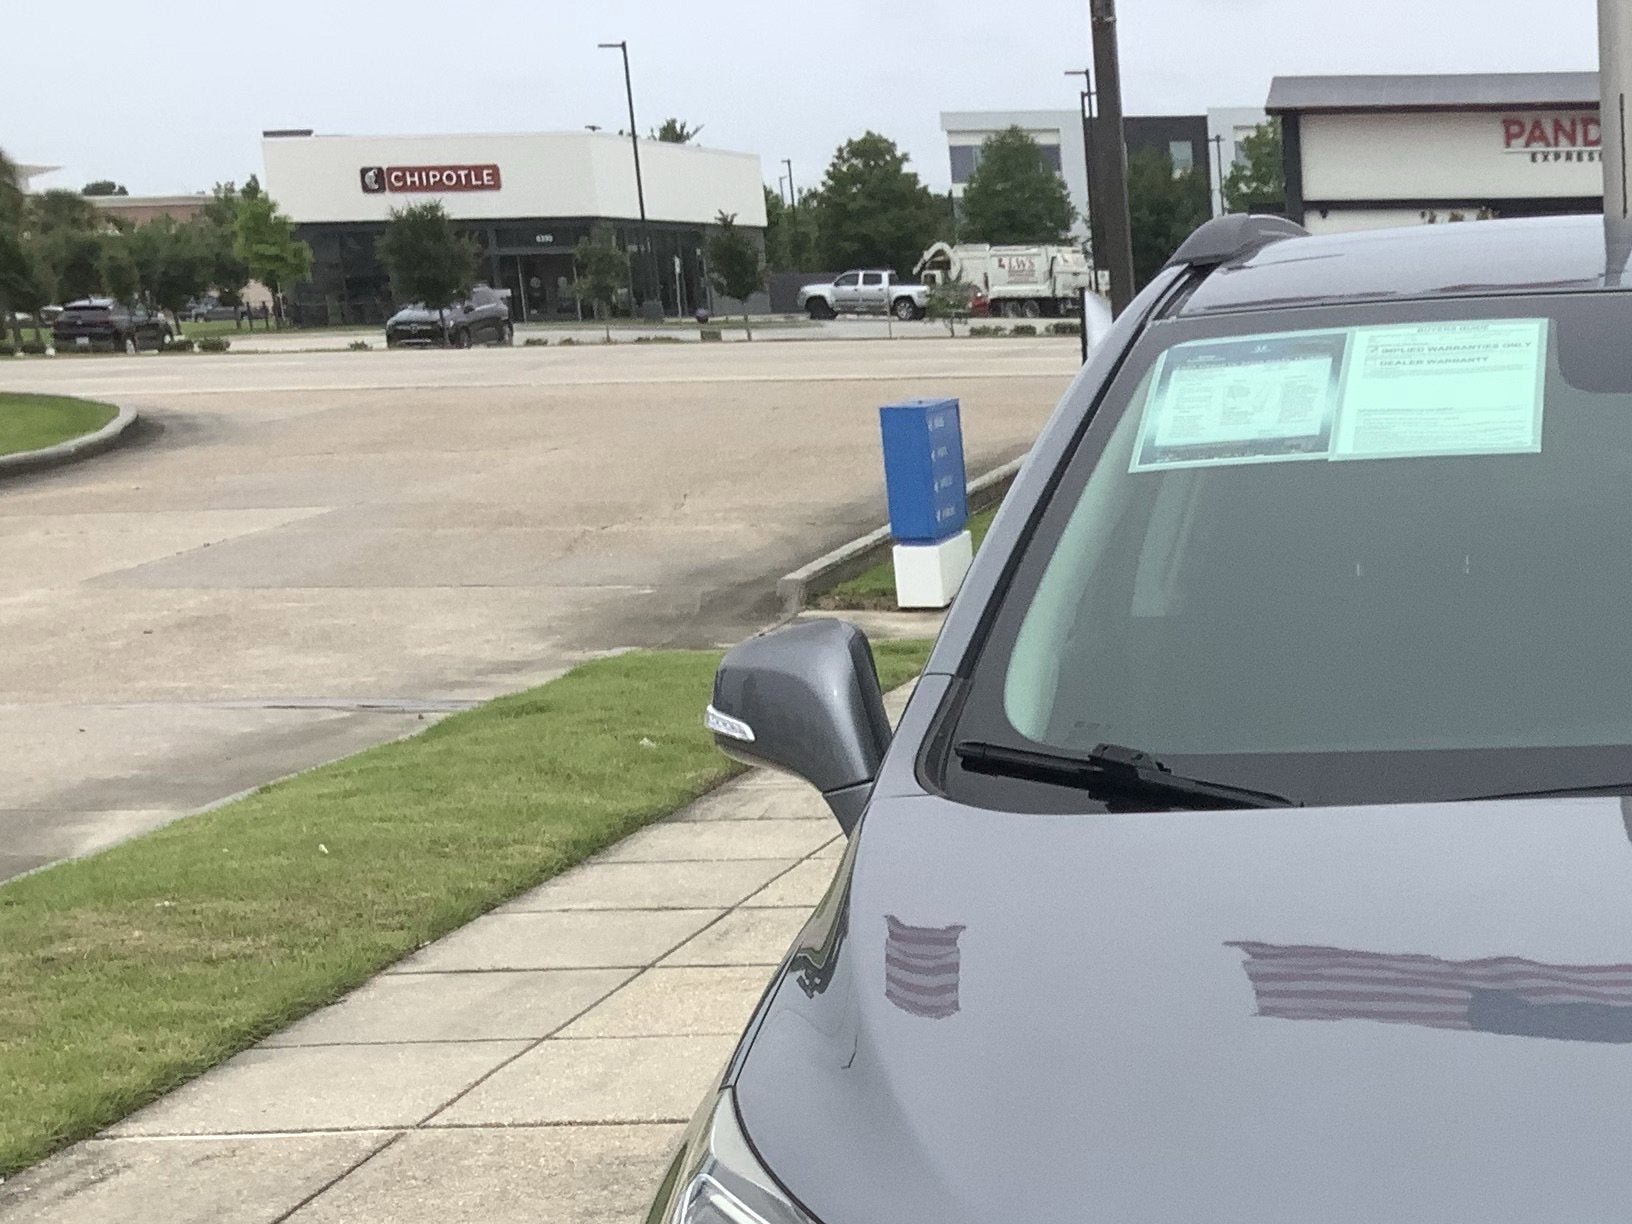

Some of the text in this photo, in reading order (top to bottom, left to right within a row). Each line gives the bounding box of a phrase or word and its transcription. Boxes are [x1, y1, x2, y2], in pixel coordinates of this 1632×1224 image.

[1502, 116, 1602, 149] PAND
[1530, 150, 1602, 163] EXPRES
[390, 169, 495, 188] CHIPOTLE
